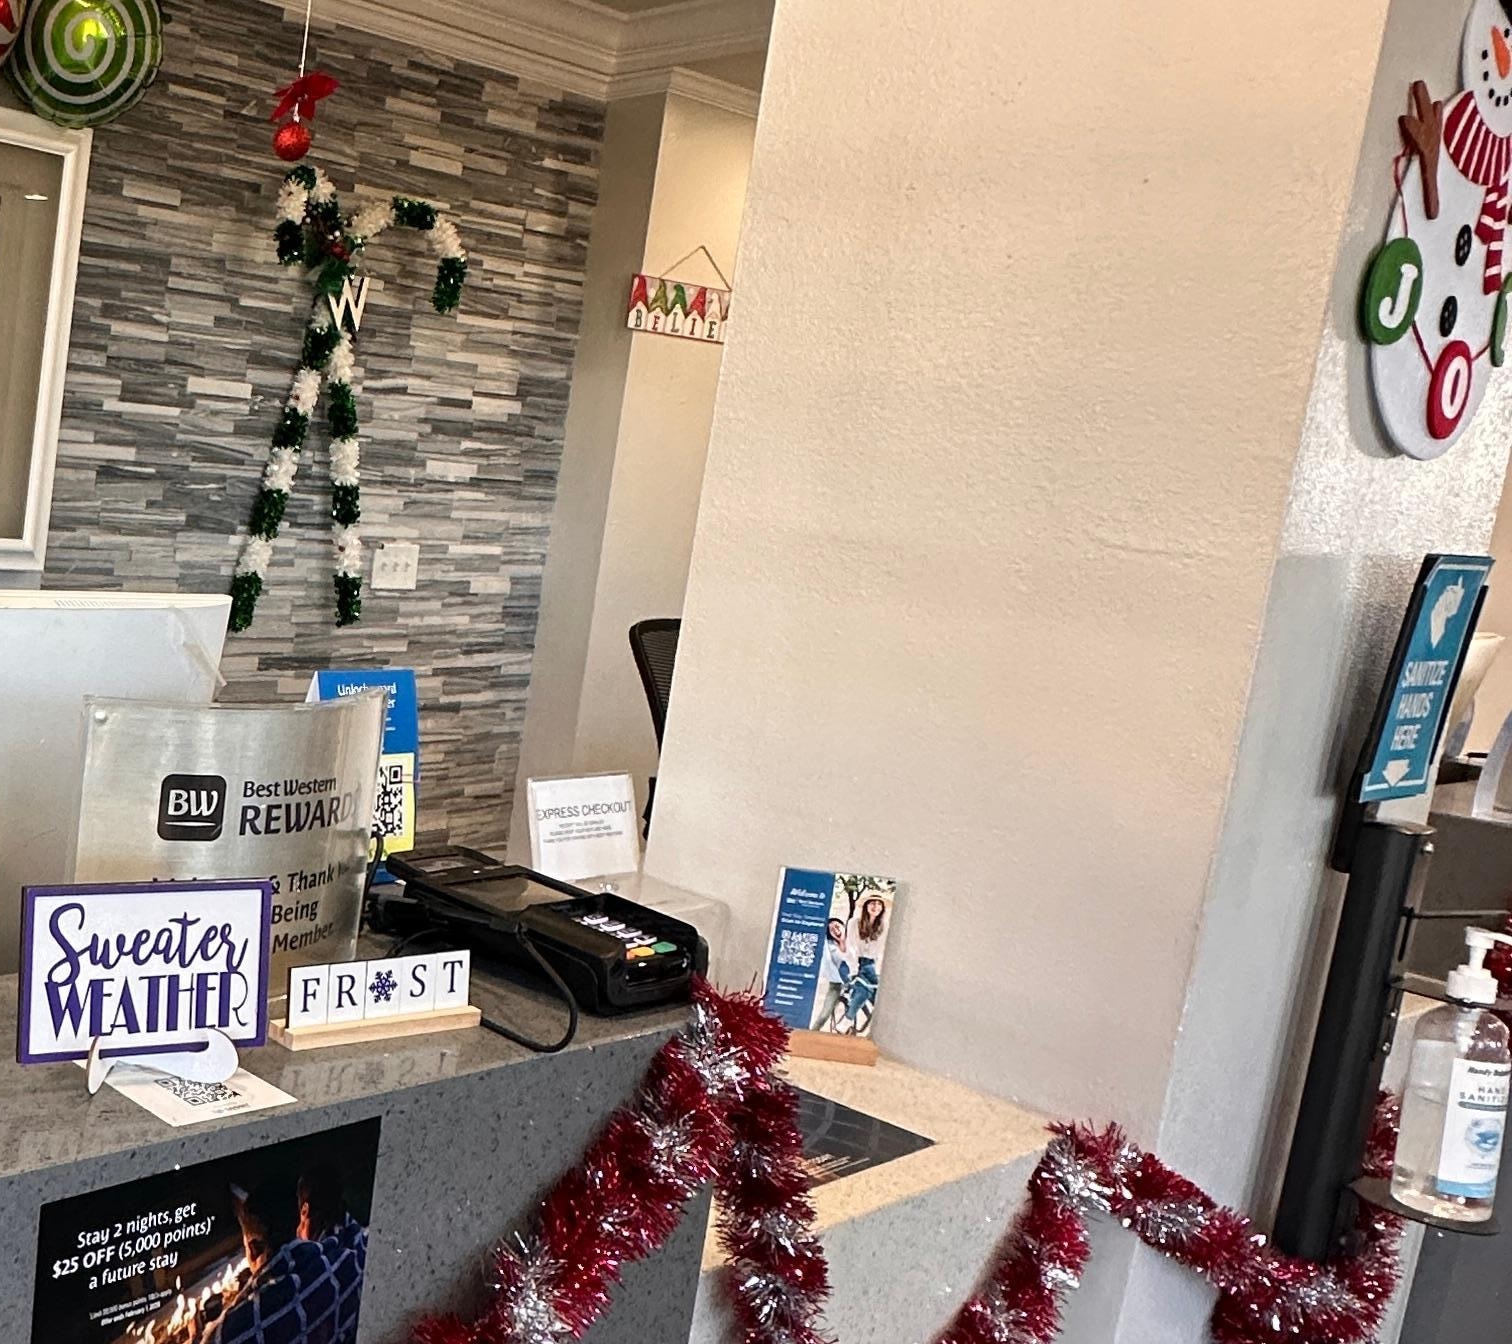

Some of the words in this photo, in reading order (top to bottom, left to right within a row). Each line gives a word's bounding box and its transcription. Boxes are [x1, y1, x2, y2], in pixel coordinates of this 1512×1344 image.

[327, 275, 371, 332] W
[1401, 660, 1449, 689] SANITIZE
[1395, 691, 1434, 720] HANDS
[1390, 724, 1422, 752] HERE
[168, 789, 219, 817] BW
[243, 781, 281, 798] Best
[284, 777, 337, 796] Western
[238, 789, 359, 836] REWARD
[536, 805, 580, 821] EXPRESS
[581, 800, 631, 817] CHECKOUT
[269, 875, 281, 895] &
[288, 864, 336, 893] Thank
[271, 899, 320, 925] Being
[46, 902, 248, 984] Sweater
[44, 971, 249, 1042] WEATHER
[77, 1225, 111, 1249] Stay
[113, 1223, 123, 1237] 2
[125, 1210, 174, 1237] nights,
[174, 1202, 197, 1224] get
[52, 1259, 79, 1280] $25
[83, 1248, 116, 1269] OFF
[118, 1234, 162, 1262] (5,000
[88, 1276, 98, 1290] a
[102, 1261, 146, 1286] future
[148, 1251, 179, 1275] stay
